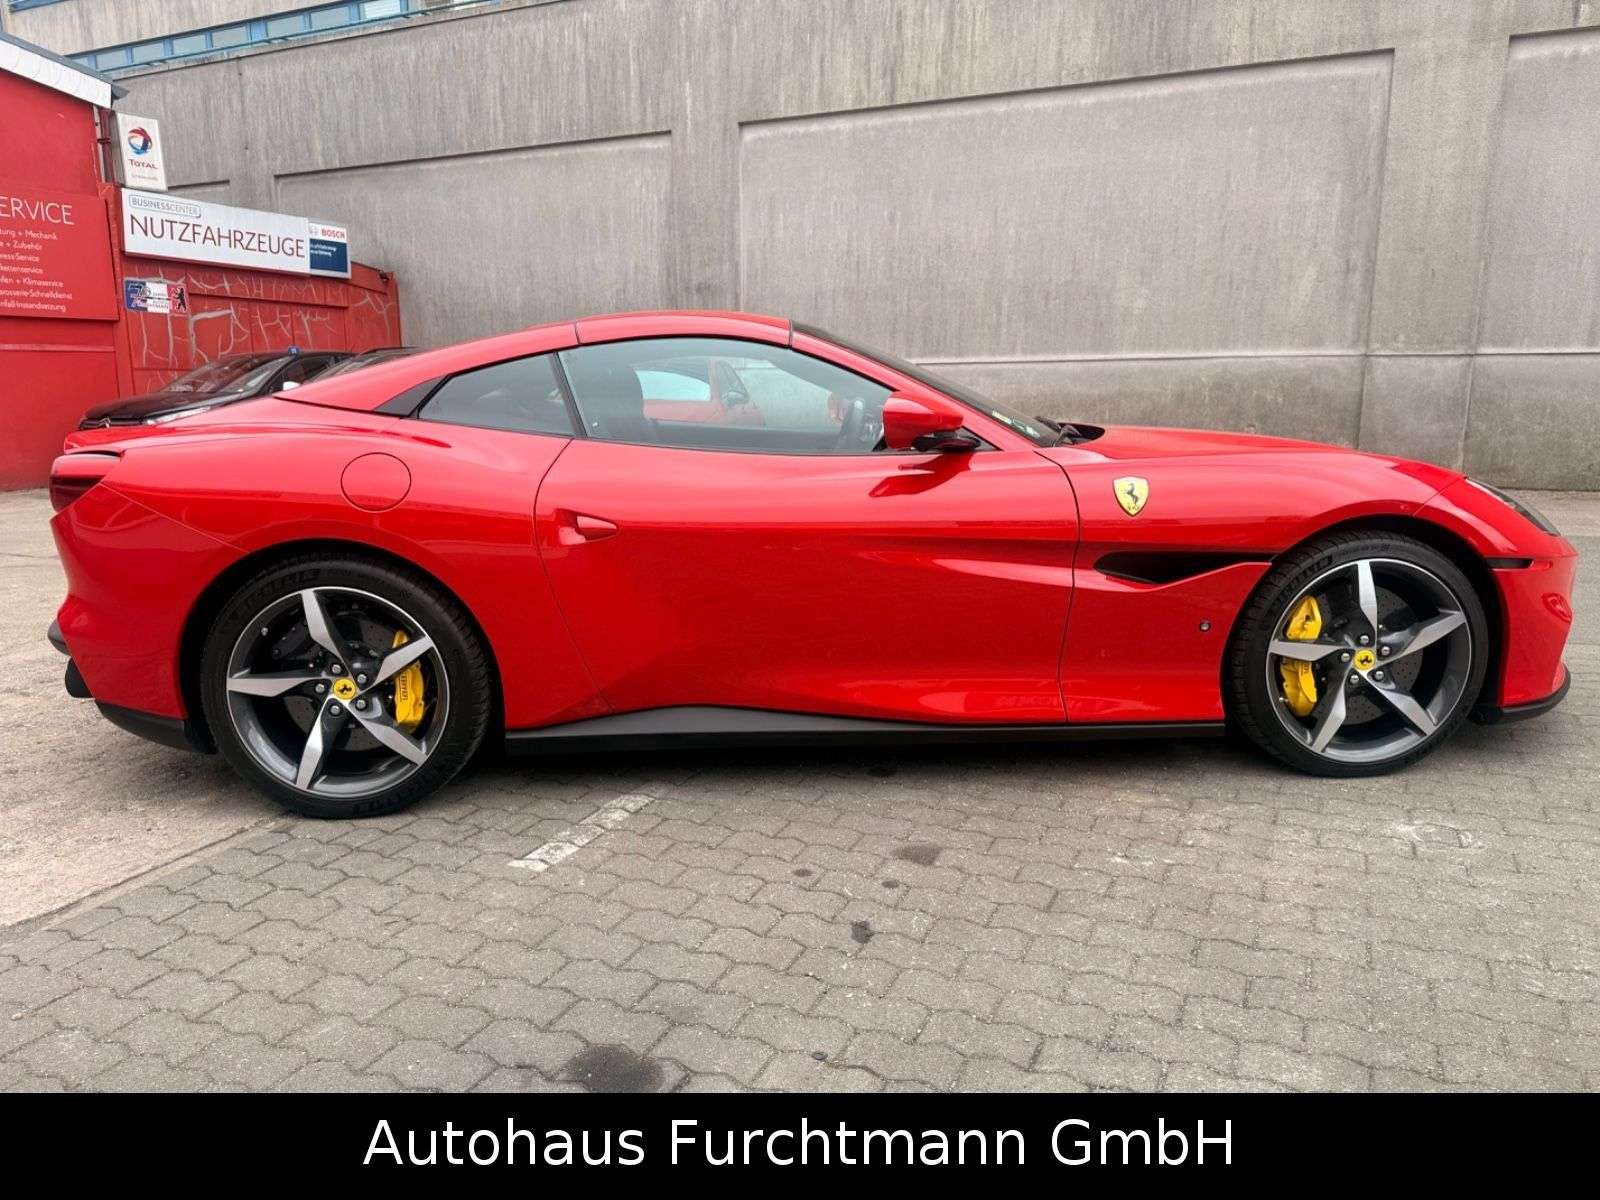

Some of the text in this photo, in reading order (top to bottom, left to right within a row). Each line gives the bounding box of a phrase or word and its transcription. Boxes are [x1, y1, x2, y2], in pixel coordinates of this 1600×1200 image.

[127, 158, 158, 169] TOTAL
[131, 197, 198, 215] BUSINESSCENTER
[130, 214, 305, 258] NUTZFAHRZEUGE
[321, 228, 345, 239] BOSCH
